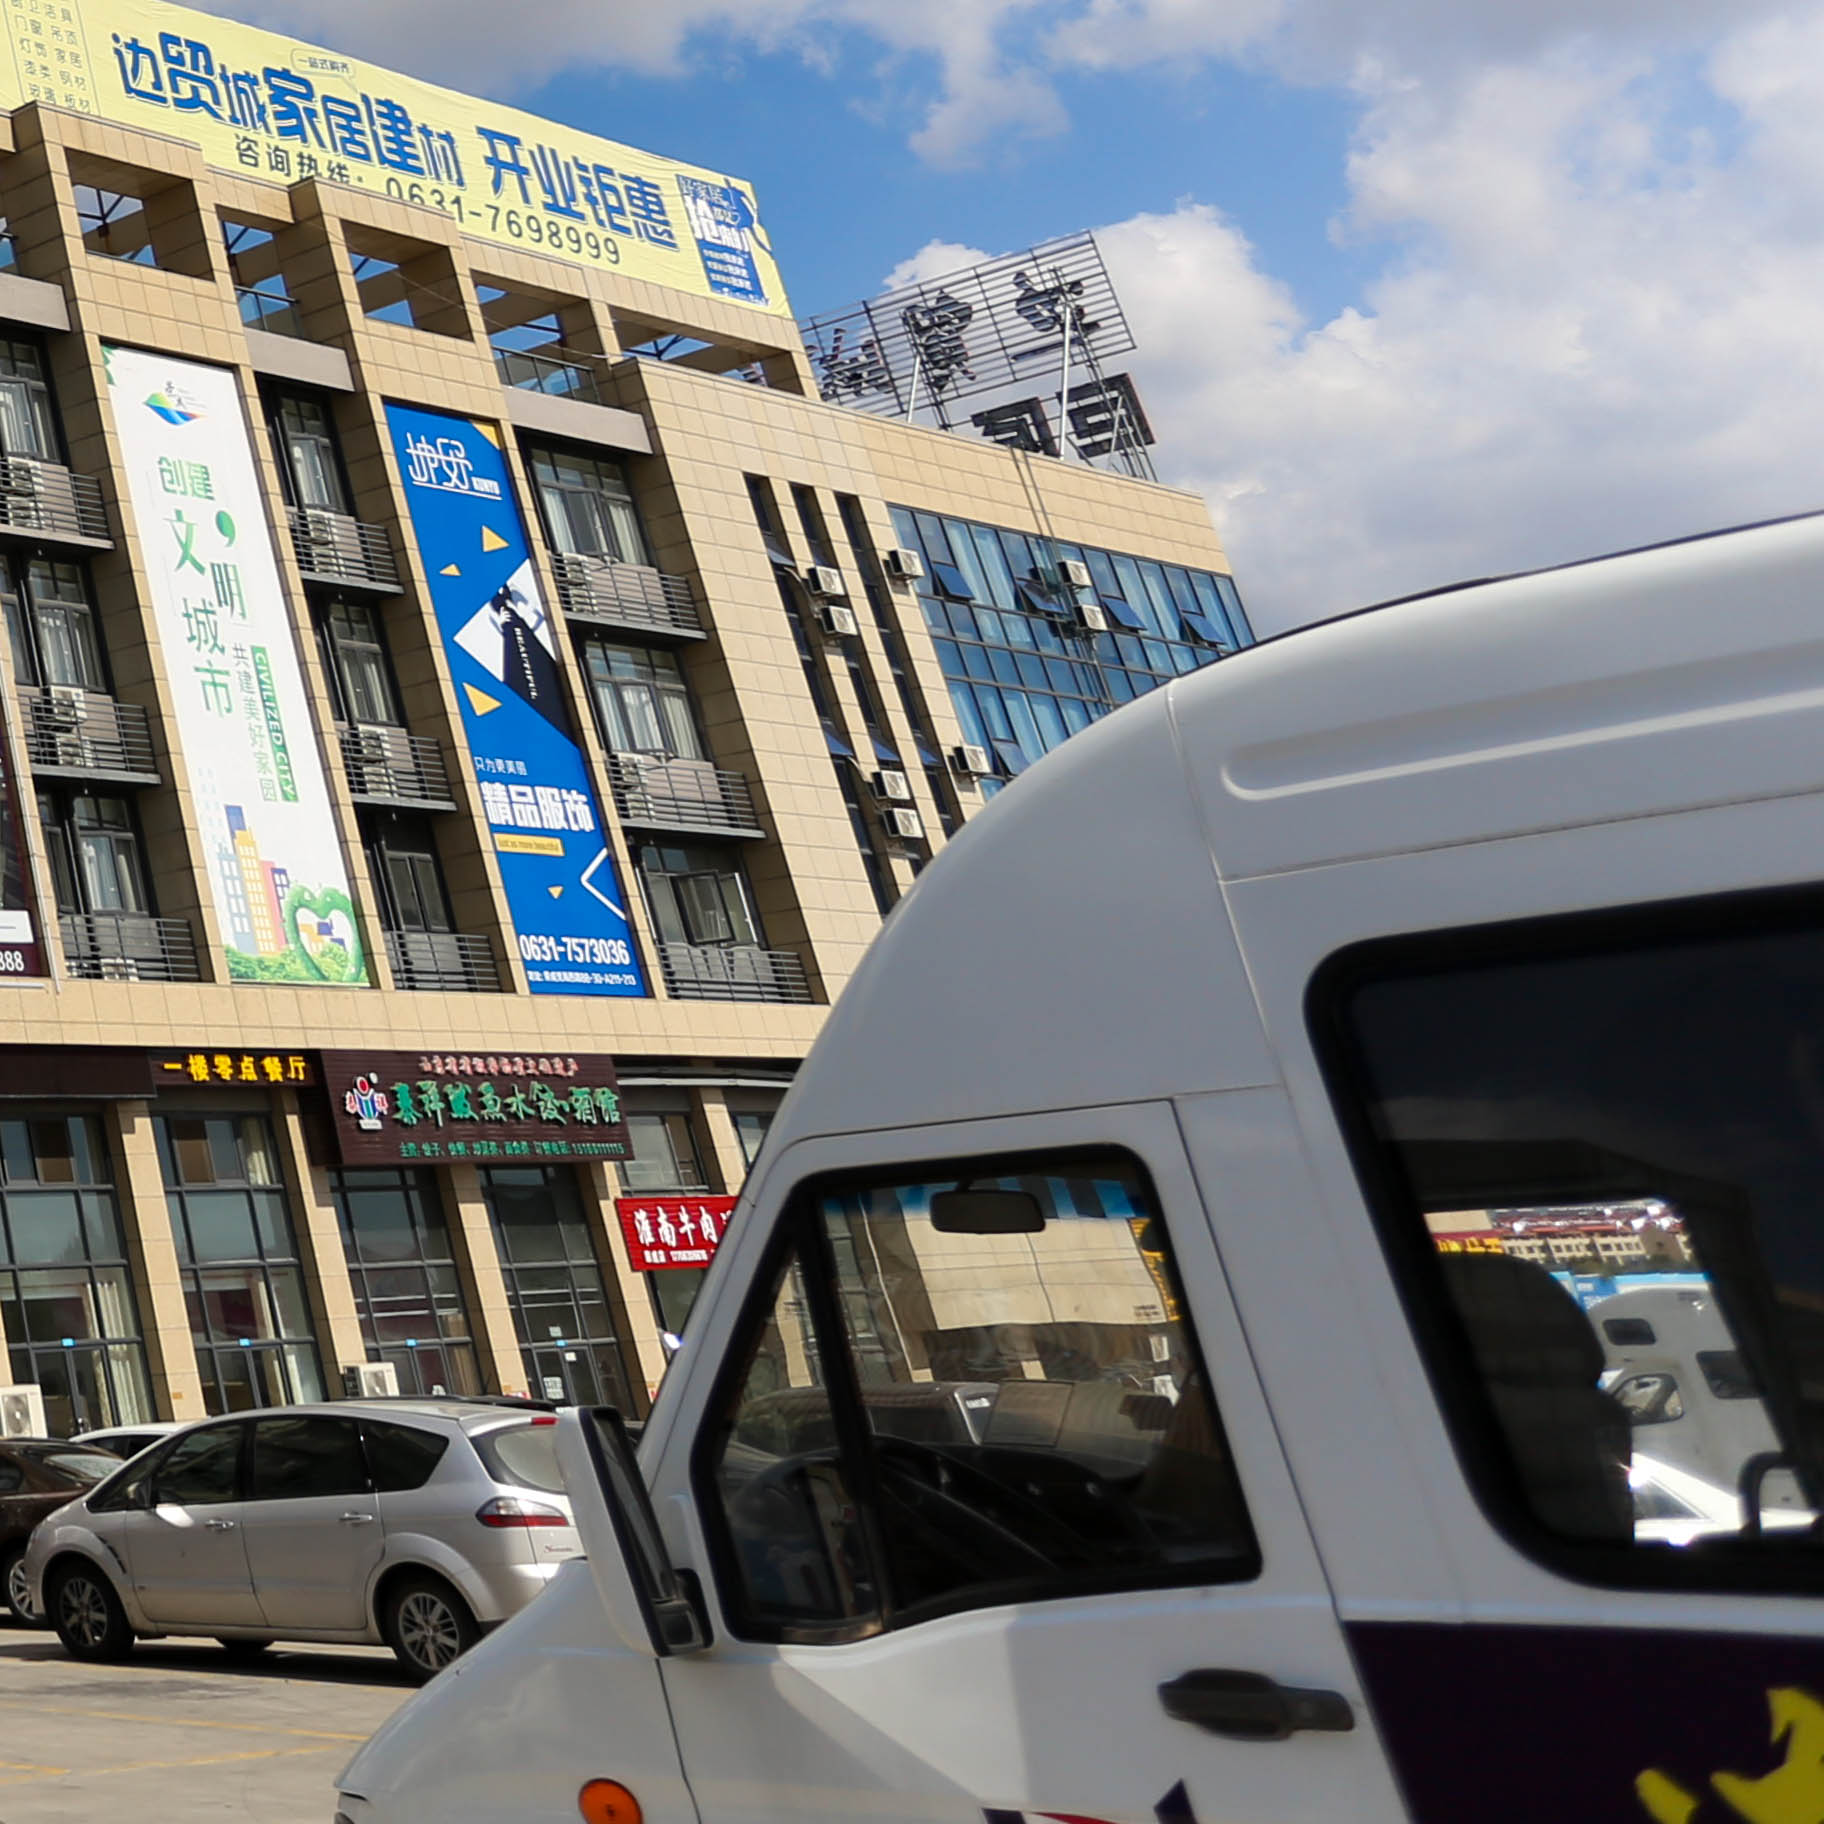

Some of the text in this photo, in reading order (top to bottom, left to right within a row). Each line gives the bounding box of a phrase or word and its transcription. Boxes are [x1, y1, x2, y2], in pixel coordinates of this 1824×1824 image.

[111, 30, 465, 190] 边贸城家居建材
[255, 652, 295, 795] CIVILIZED CITY
[480, 780, 596, 833] 精品服饰
[519, 934, 631, 965] 0631-7573036
[633, 1204, 733, 1248] 淮南牛肉
